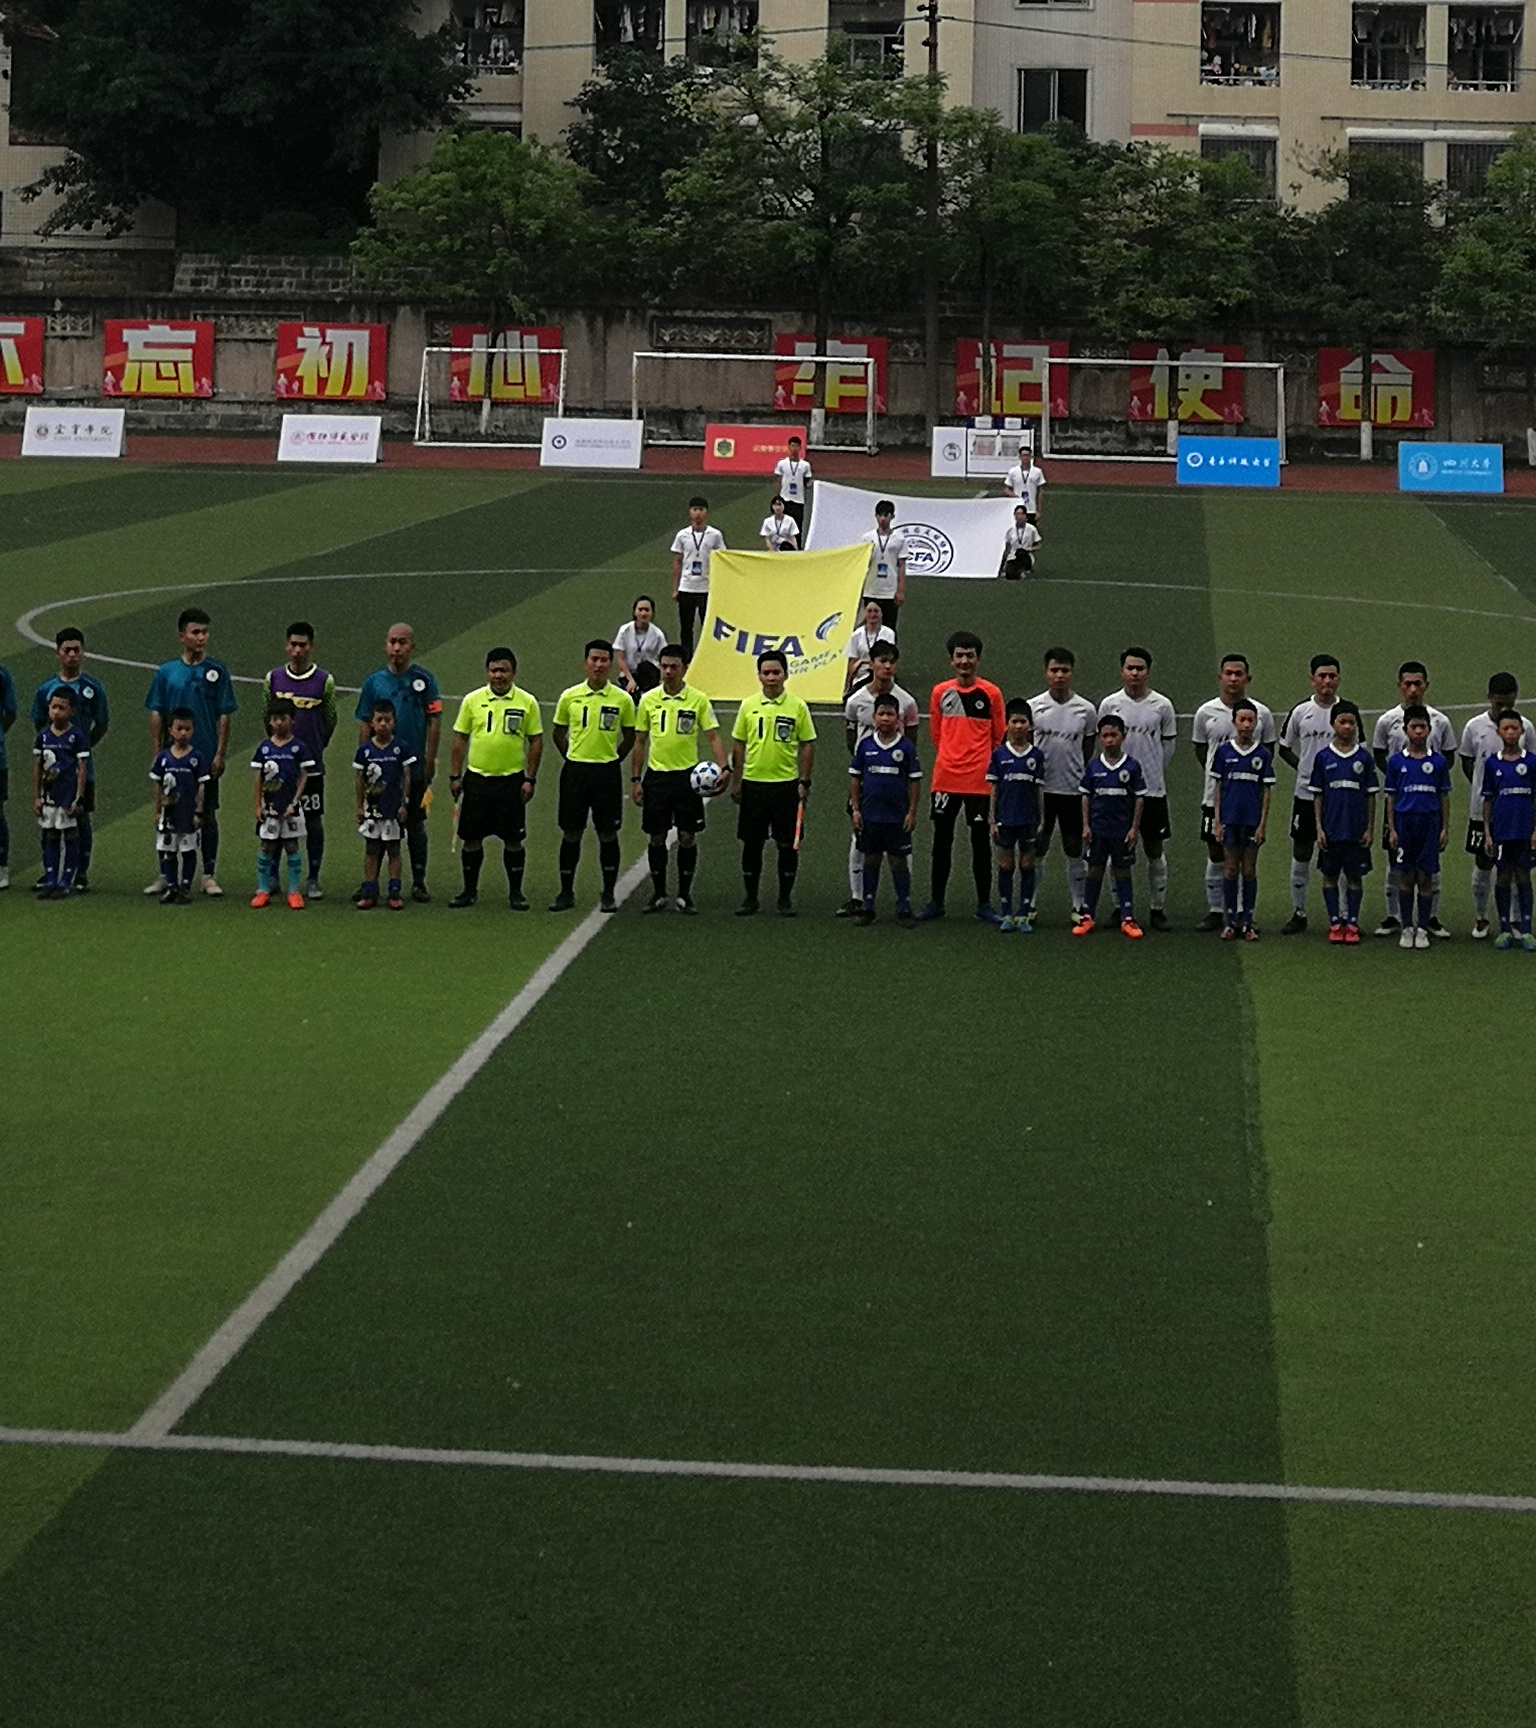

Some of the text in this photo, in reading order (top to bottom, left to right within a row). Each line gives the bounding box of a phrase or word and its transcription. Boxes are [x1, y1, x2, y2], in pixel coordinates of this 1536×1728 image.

[122, 325, 196, 393] 忘
[296, 327, 369, 397] 初
[1150, 349, 1223, 421] 使
[1340, 354, 1412, 424] 命
[713, 616, 804, 657] FIFA
[301, 793, 321, 811] 28
[934, 791, 950, 809] 99
